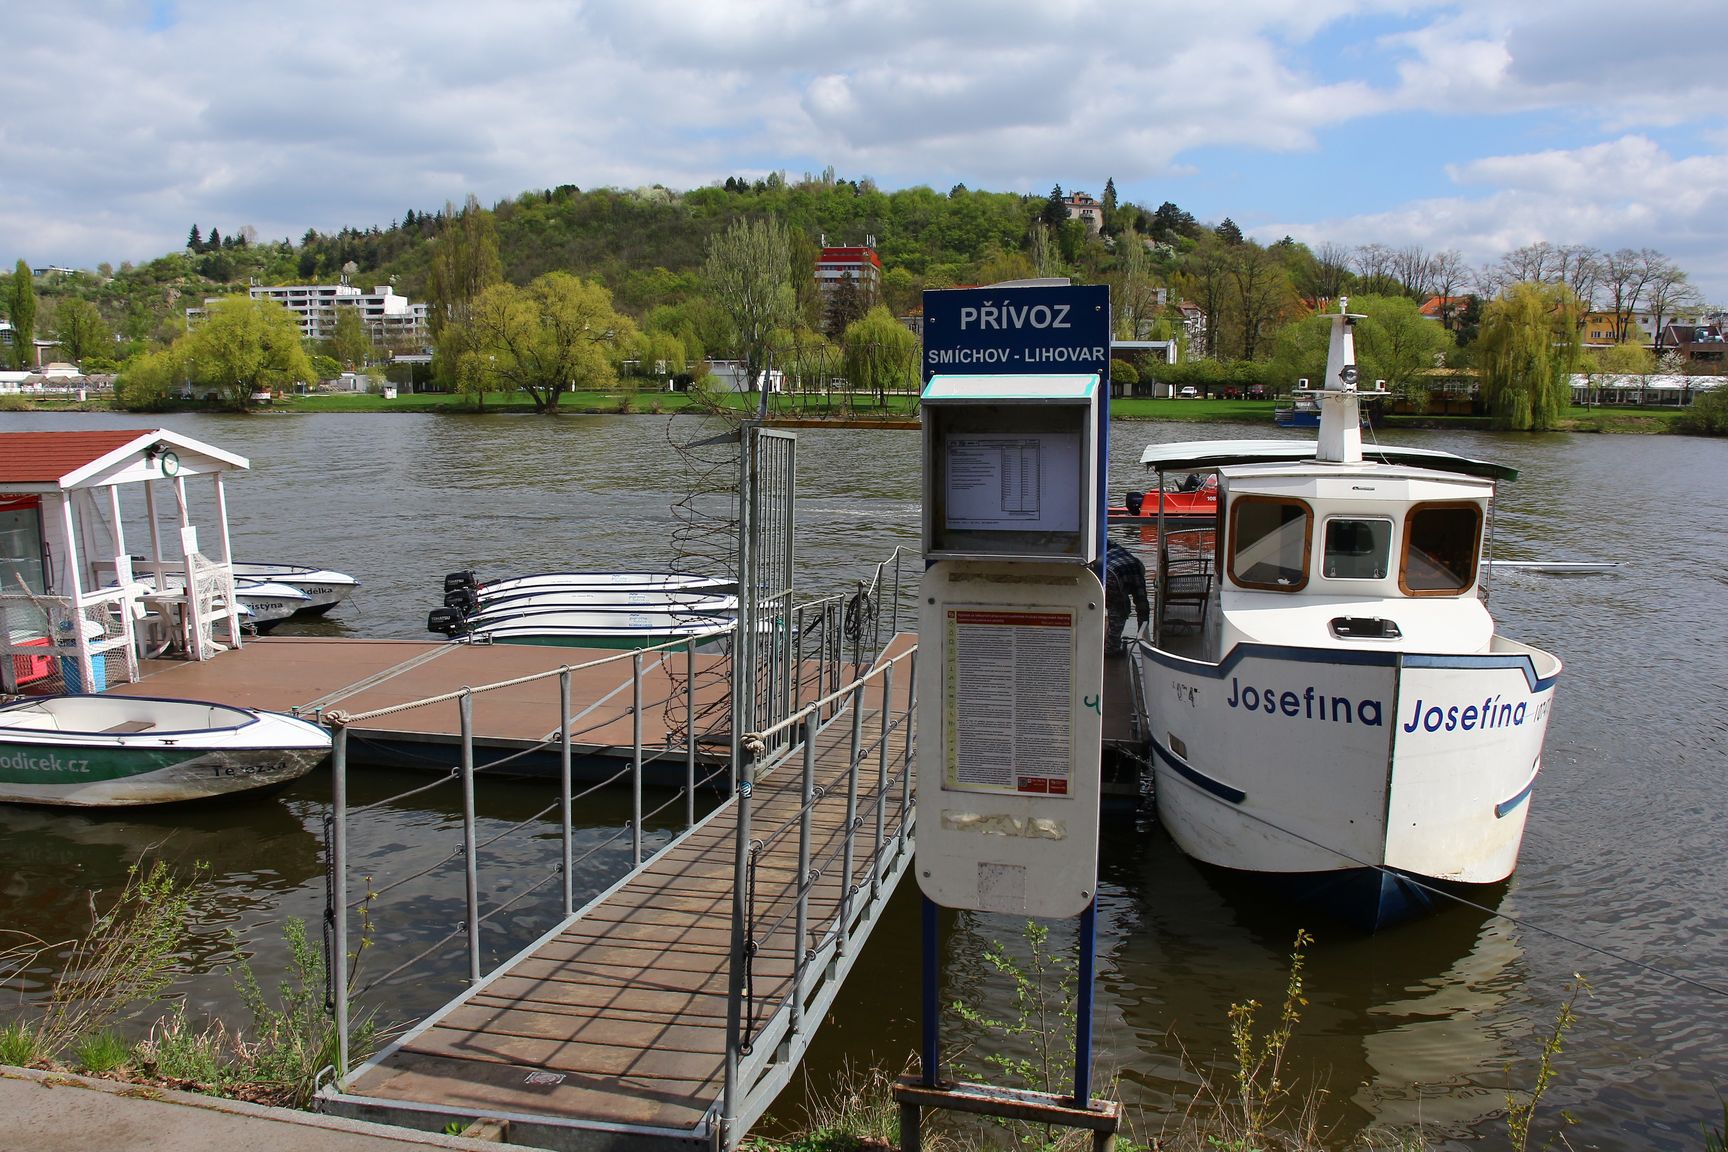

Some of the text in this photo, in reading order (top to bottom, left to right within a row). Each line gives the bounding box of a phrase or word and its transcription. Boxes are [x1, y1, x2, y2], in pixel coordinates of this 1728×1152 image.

[961, 300, 1071, 330] PŘÍVOZ
[928, 345, 1010, 364] SMÍCHOV
[1025, 346, 1105, 363] LIHOVAR
[1404, 694, 1528, 733] Josefína
